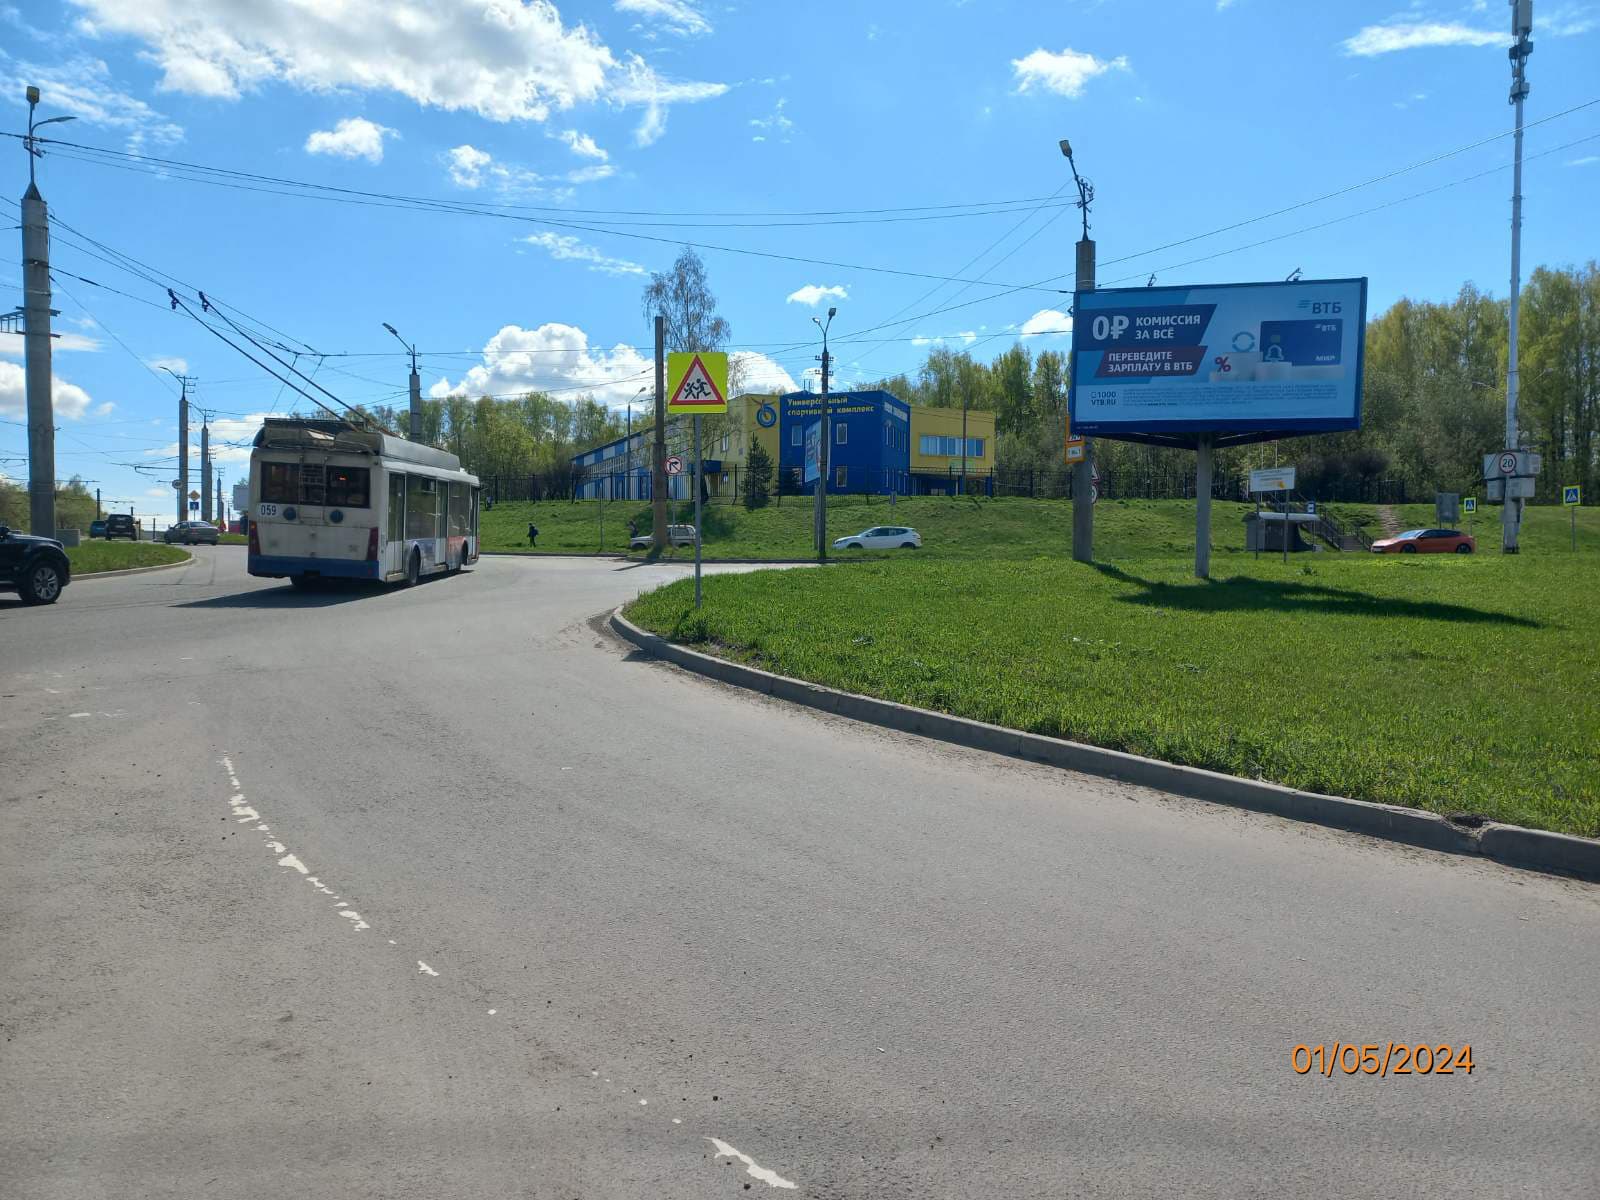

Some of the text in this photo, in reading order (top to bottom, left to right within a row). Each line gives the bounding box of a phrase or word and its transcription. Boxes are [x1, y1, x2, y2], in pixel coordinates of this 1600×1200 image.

[1312, 302, 1342, 314] ВТБ
[1136, 315, 1201, 326] КОМИССИЯ
[1135, 328, 1174, 339] ЗА ВСЁ
[1108, 351, 1172, 361] ПЕРЕВЕДИТЕ
[1108, 362, 1192, 372] ЗАРПЛАТУ В ВТБ
[1503, 458, 1513, 467] 20
[260, 504, 276, 515] 059
